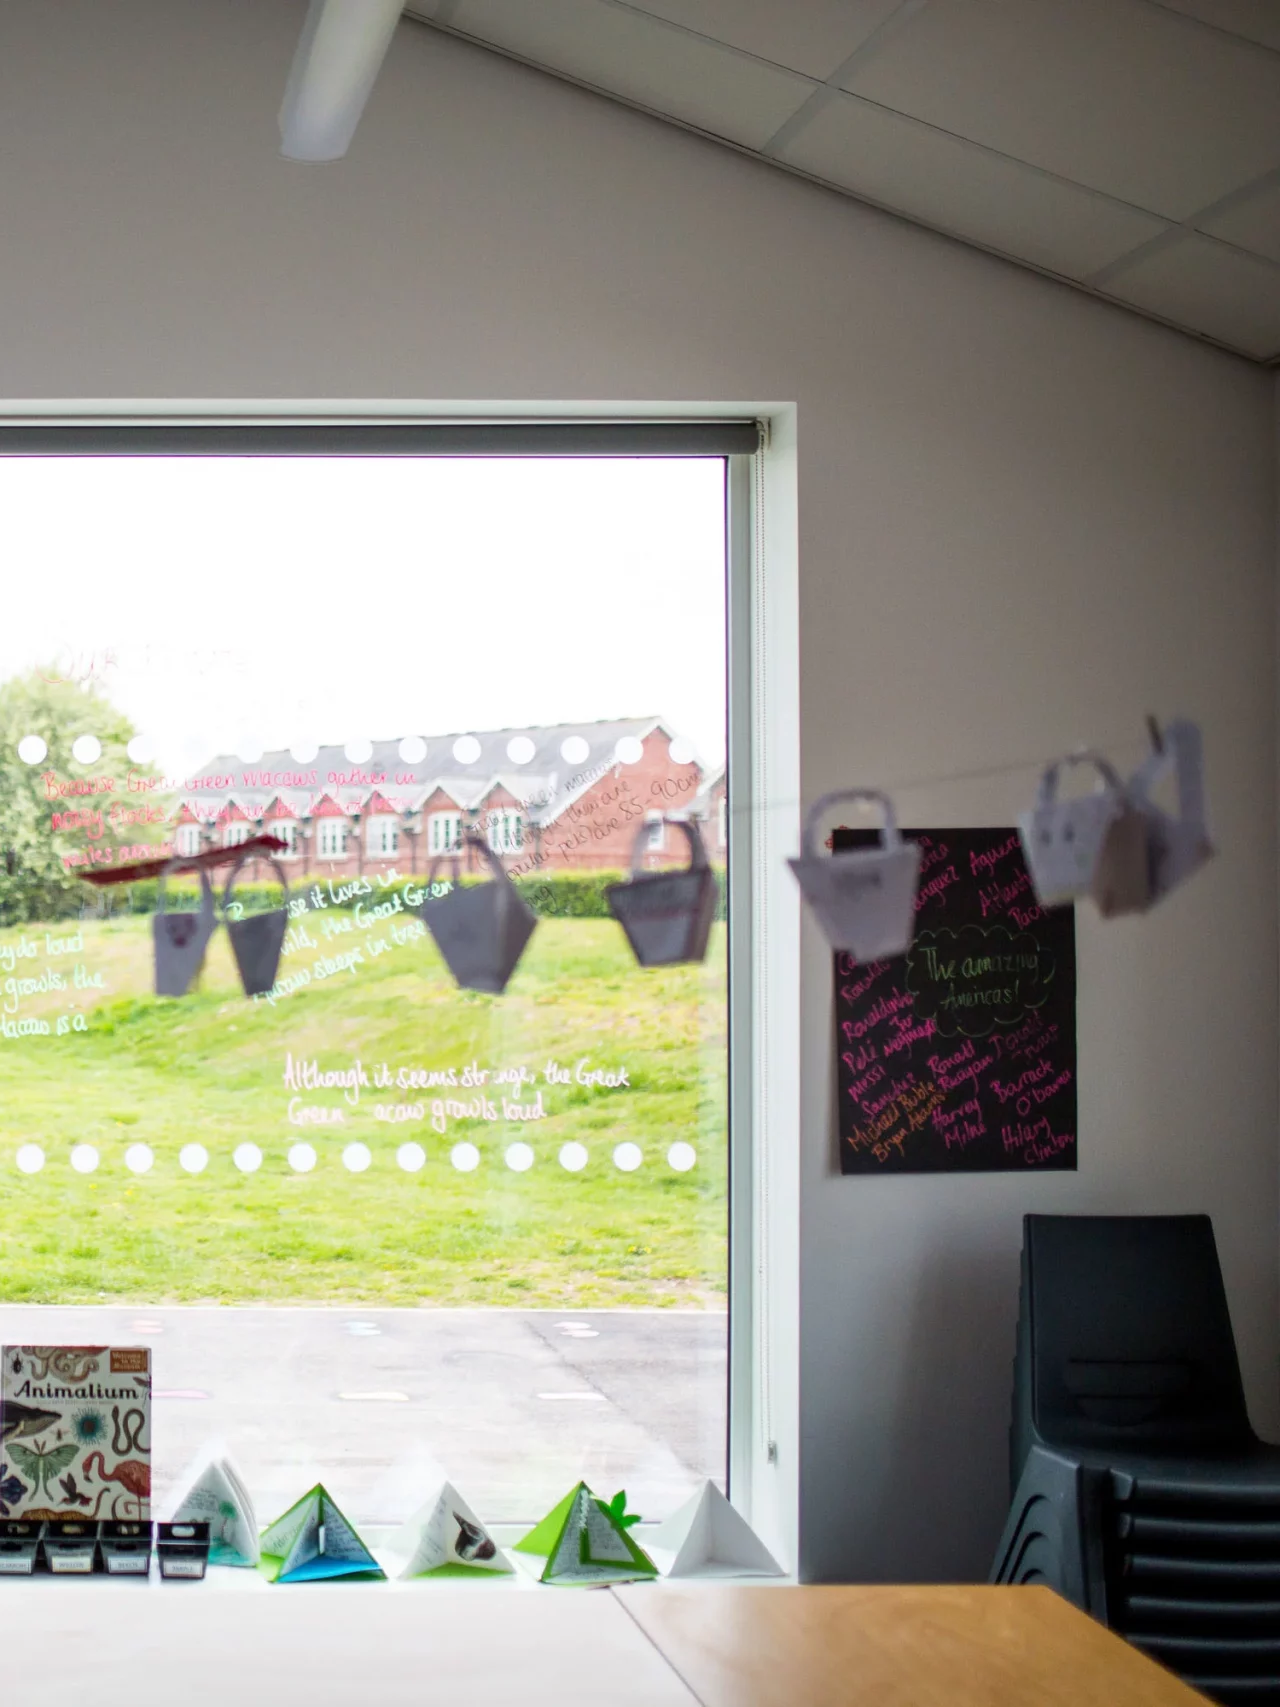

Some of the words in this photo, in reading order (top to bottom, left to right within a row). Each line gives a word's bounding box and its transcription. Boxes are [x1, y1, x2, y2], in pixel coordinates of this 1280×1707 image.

[40, 770, 118, 802] Because
[326, 769, 388, 799] gather
[601, 780, 632, 805] are
[593, 817, 620, 840] are
[309, 884, 329, 910] it
[375, 863, 402, 889] in
[321, 915, 354, 942] the
[354, 891, 404, 930] Great
[20, 936, 39, 959] do
[45, 931, 85, 956] loud
[366, 936, 391, 957] in
[72, 963, 105, 990] the
[918, 946, 956, 983] The
[960, 948, 1039, 990] amazing
[939, 980, 1020, 1011] Americas!
[56, 1016, 71, 1037] is
[72, 1014, 89, 1032] a
[283, 1051, 370, 1105] Although
[372, 1061, 396, 1089] it
[397, 1064, 458, 1090] seems
[542, 1059, 571, 1086] the
[571, 1056, 630, 1088] Great
[286, 1095, 347, 1126] Green
[431, 1095, 497, 1134] growls
[13, 1379, 139, 1400] Animalium
